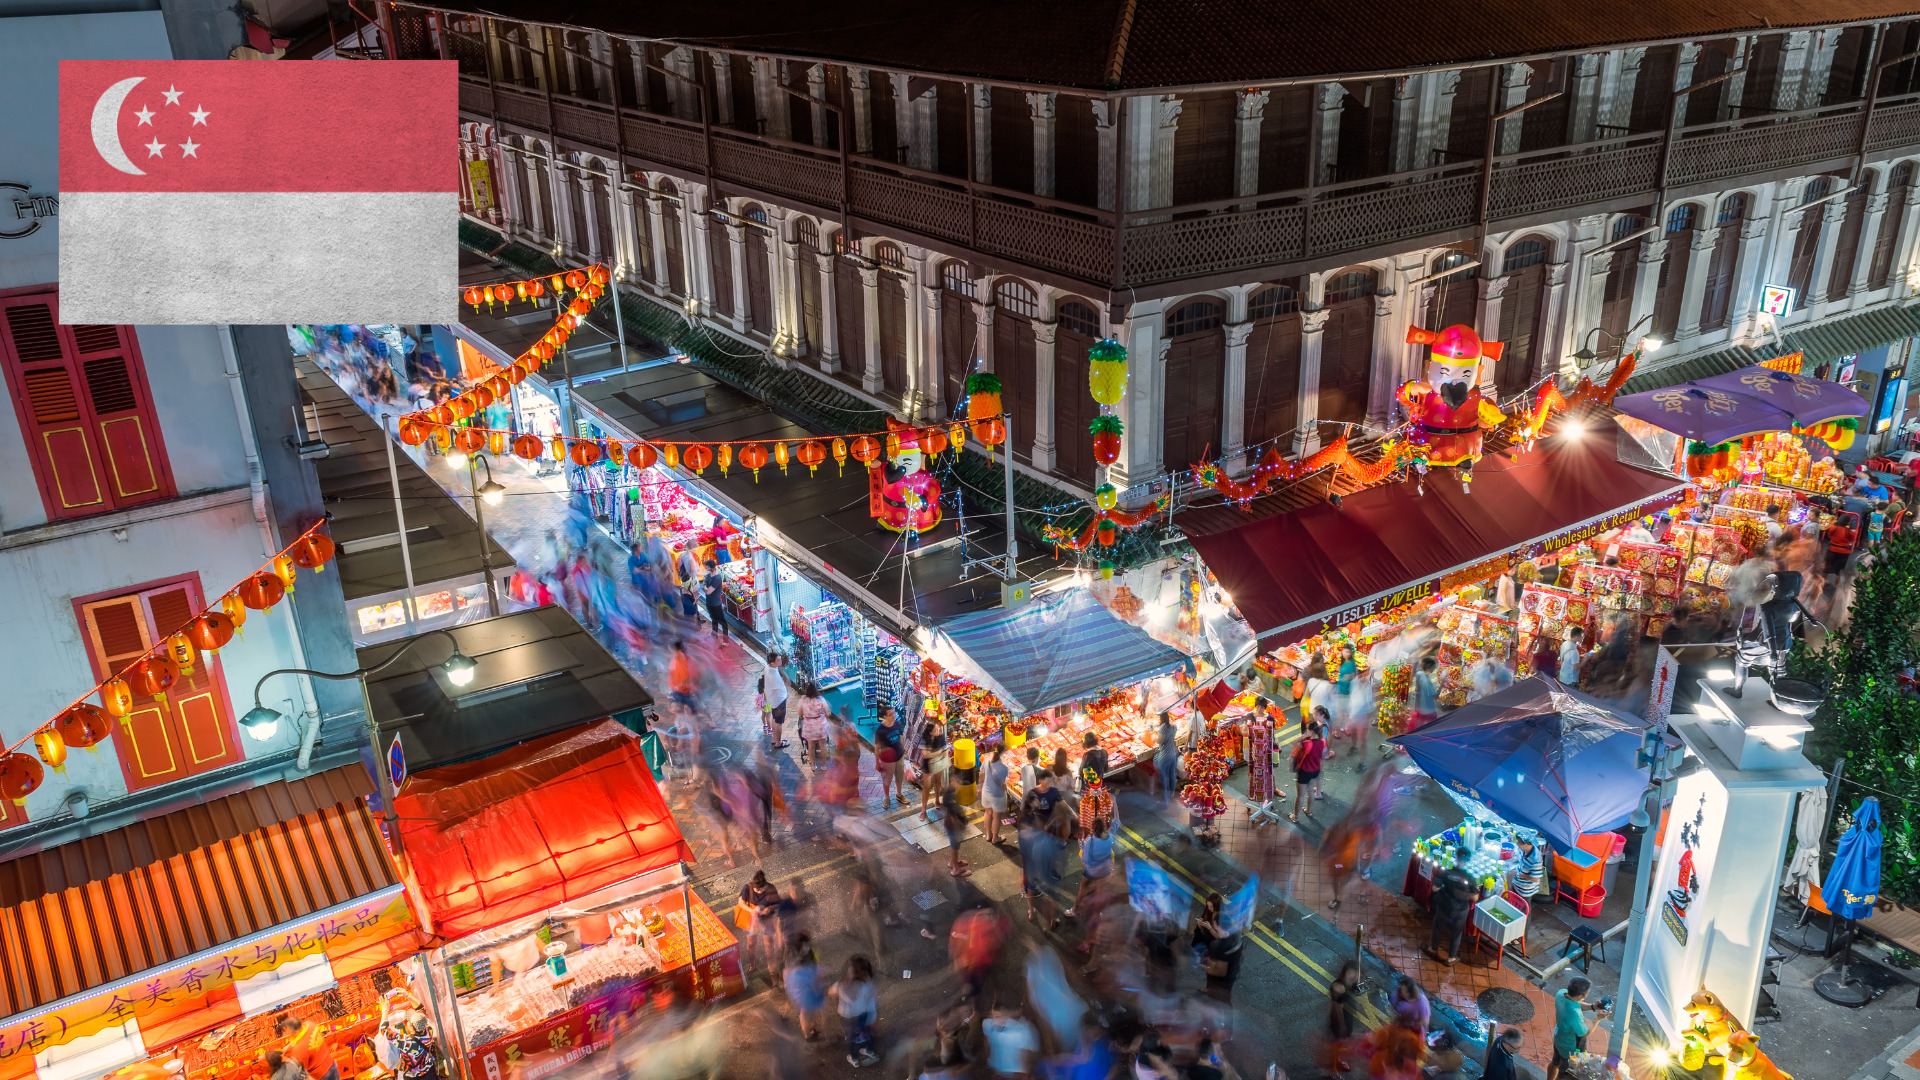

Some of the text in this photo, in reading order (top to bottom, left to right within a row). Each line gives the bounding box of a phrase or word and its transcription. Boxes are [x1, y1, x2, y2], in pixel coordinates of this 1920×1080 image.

[1544, 506, 1641, 552] Wholesale & Retail
[1336, 582, 1432, 627] LESLIE JAVELLE
[101, 908, 380, 1023] 全美香水与化妆品
[566, 1044, 593, 1063] DRIED
